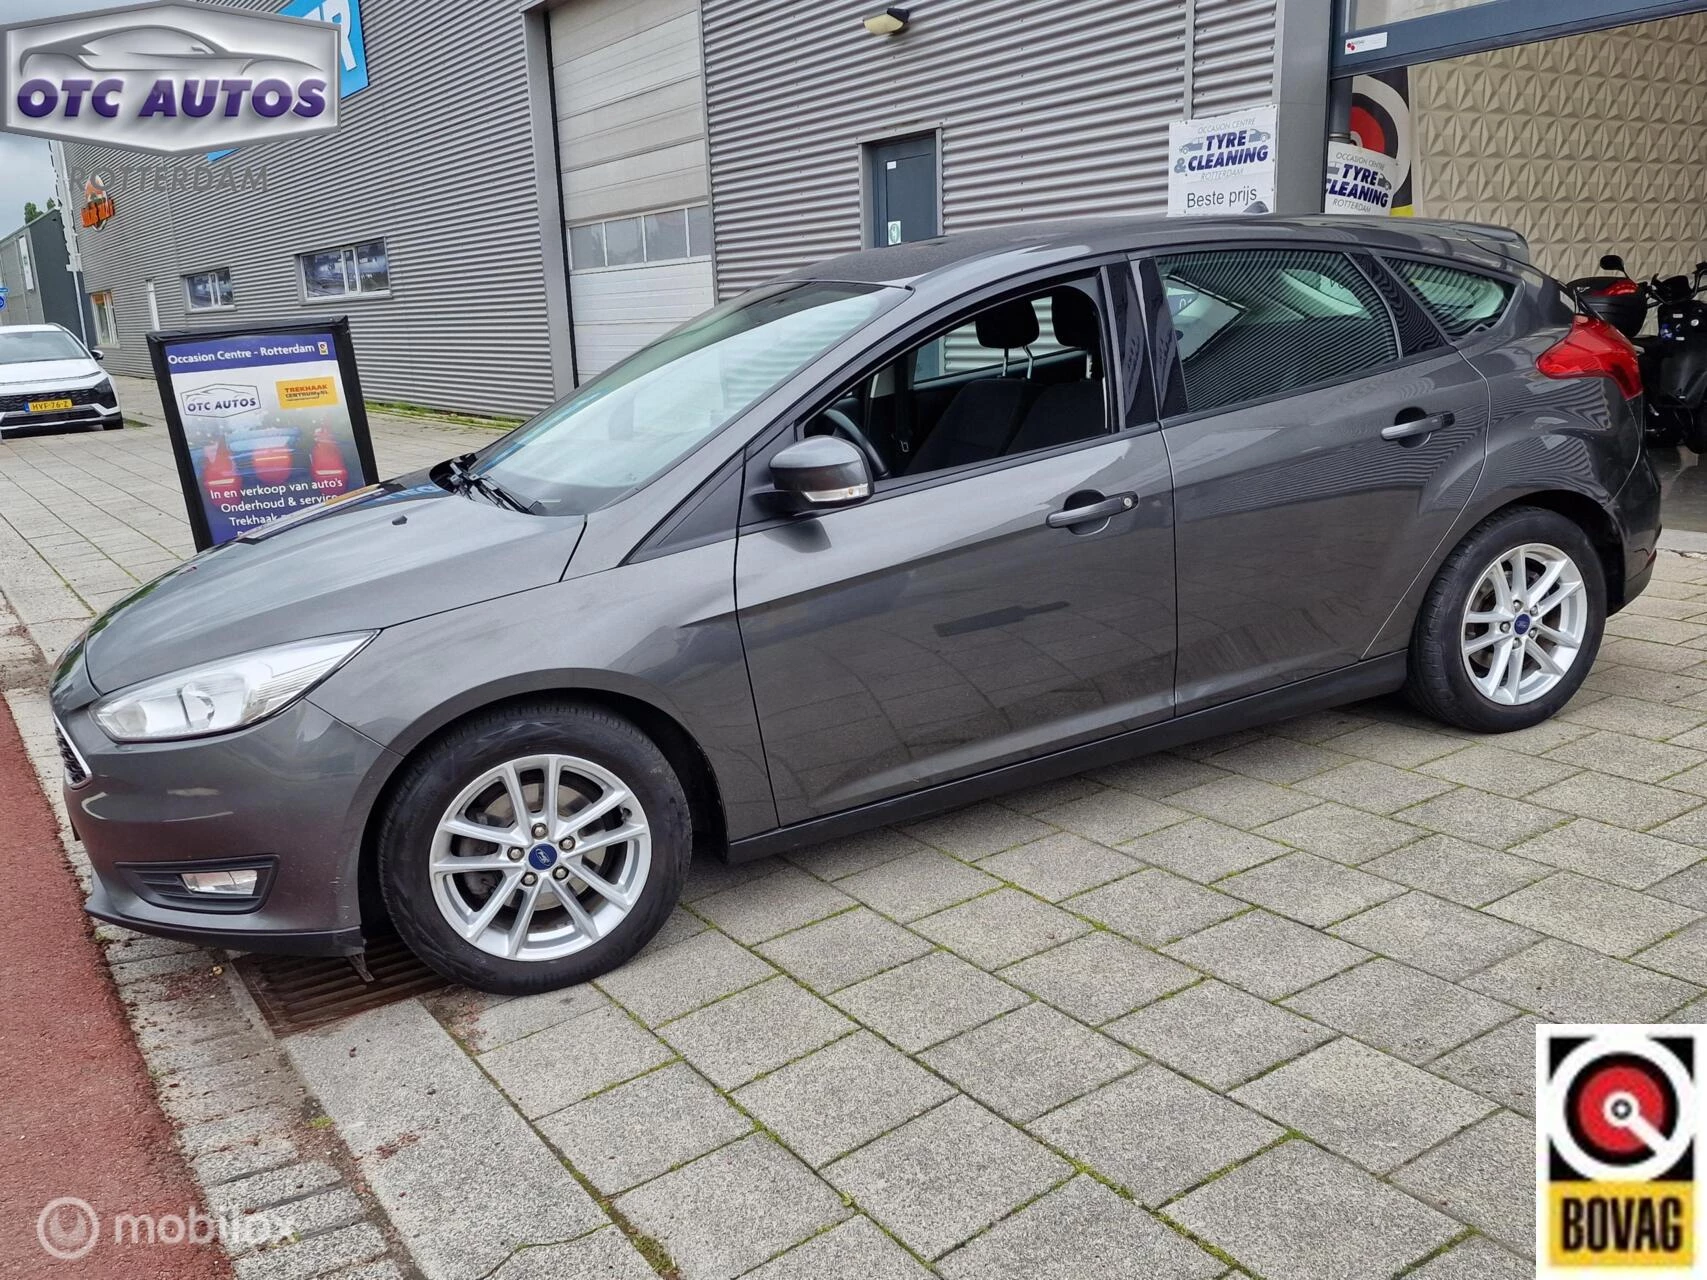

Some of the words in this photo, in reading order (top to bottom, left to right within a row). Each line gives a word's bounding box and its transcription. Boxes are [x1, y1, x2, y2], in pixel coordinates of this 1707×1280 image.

[1206, 130, 1247, 151] TYRE
[1174, 158, 1186, 173] &
[1188, 145, 1268, 171] CLEANING
[1201, 168, 1244, 181] ROTTERDAM
[1342, 164, 1378, 186] TYRE
[1187, 190, 1224, 208] Beste
[1229, 186, 1257, 207] prijs
[1333, 199, 1371, 213] ROTTERDAM
[168, 353, 215, 365] Occasion
[217, 349, 252, 361] Centre
[260, 345, 315, 357] Rotterdam
[285, 384, 328, 393] TREKHAAK
[187, 401, 210, 412] OTC
[214, 397, 257, 410] AUTOS
[210, 489, 221, 500] In
[223, 490, 237, 499] en
[240, 483, 287, 497] verkoop
[289, 482, 309, 491] van
[311, 478, 343, 490] auto's
[221, 497, 285, 513] Onderhoud
[287, 496, 297, 506] &
[228, 512, 278, 526] Trekhaak
